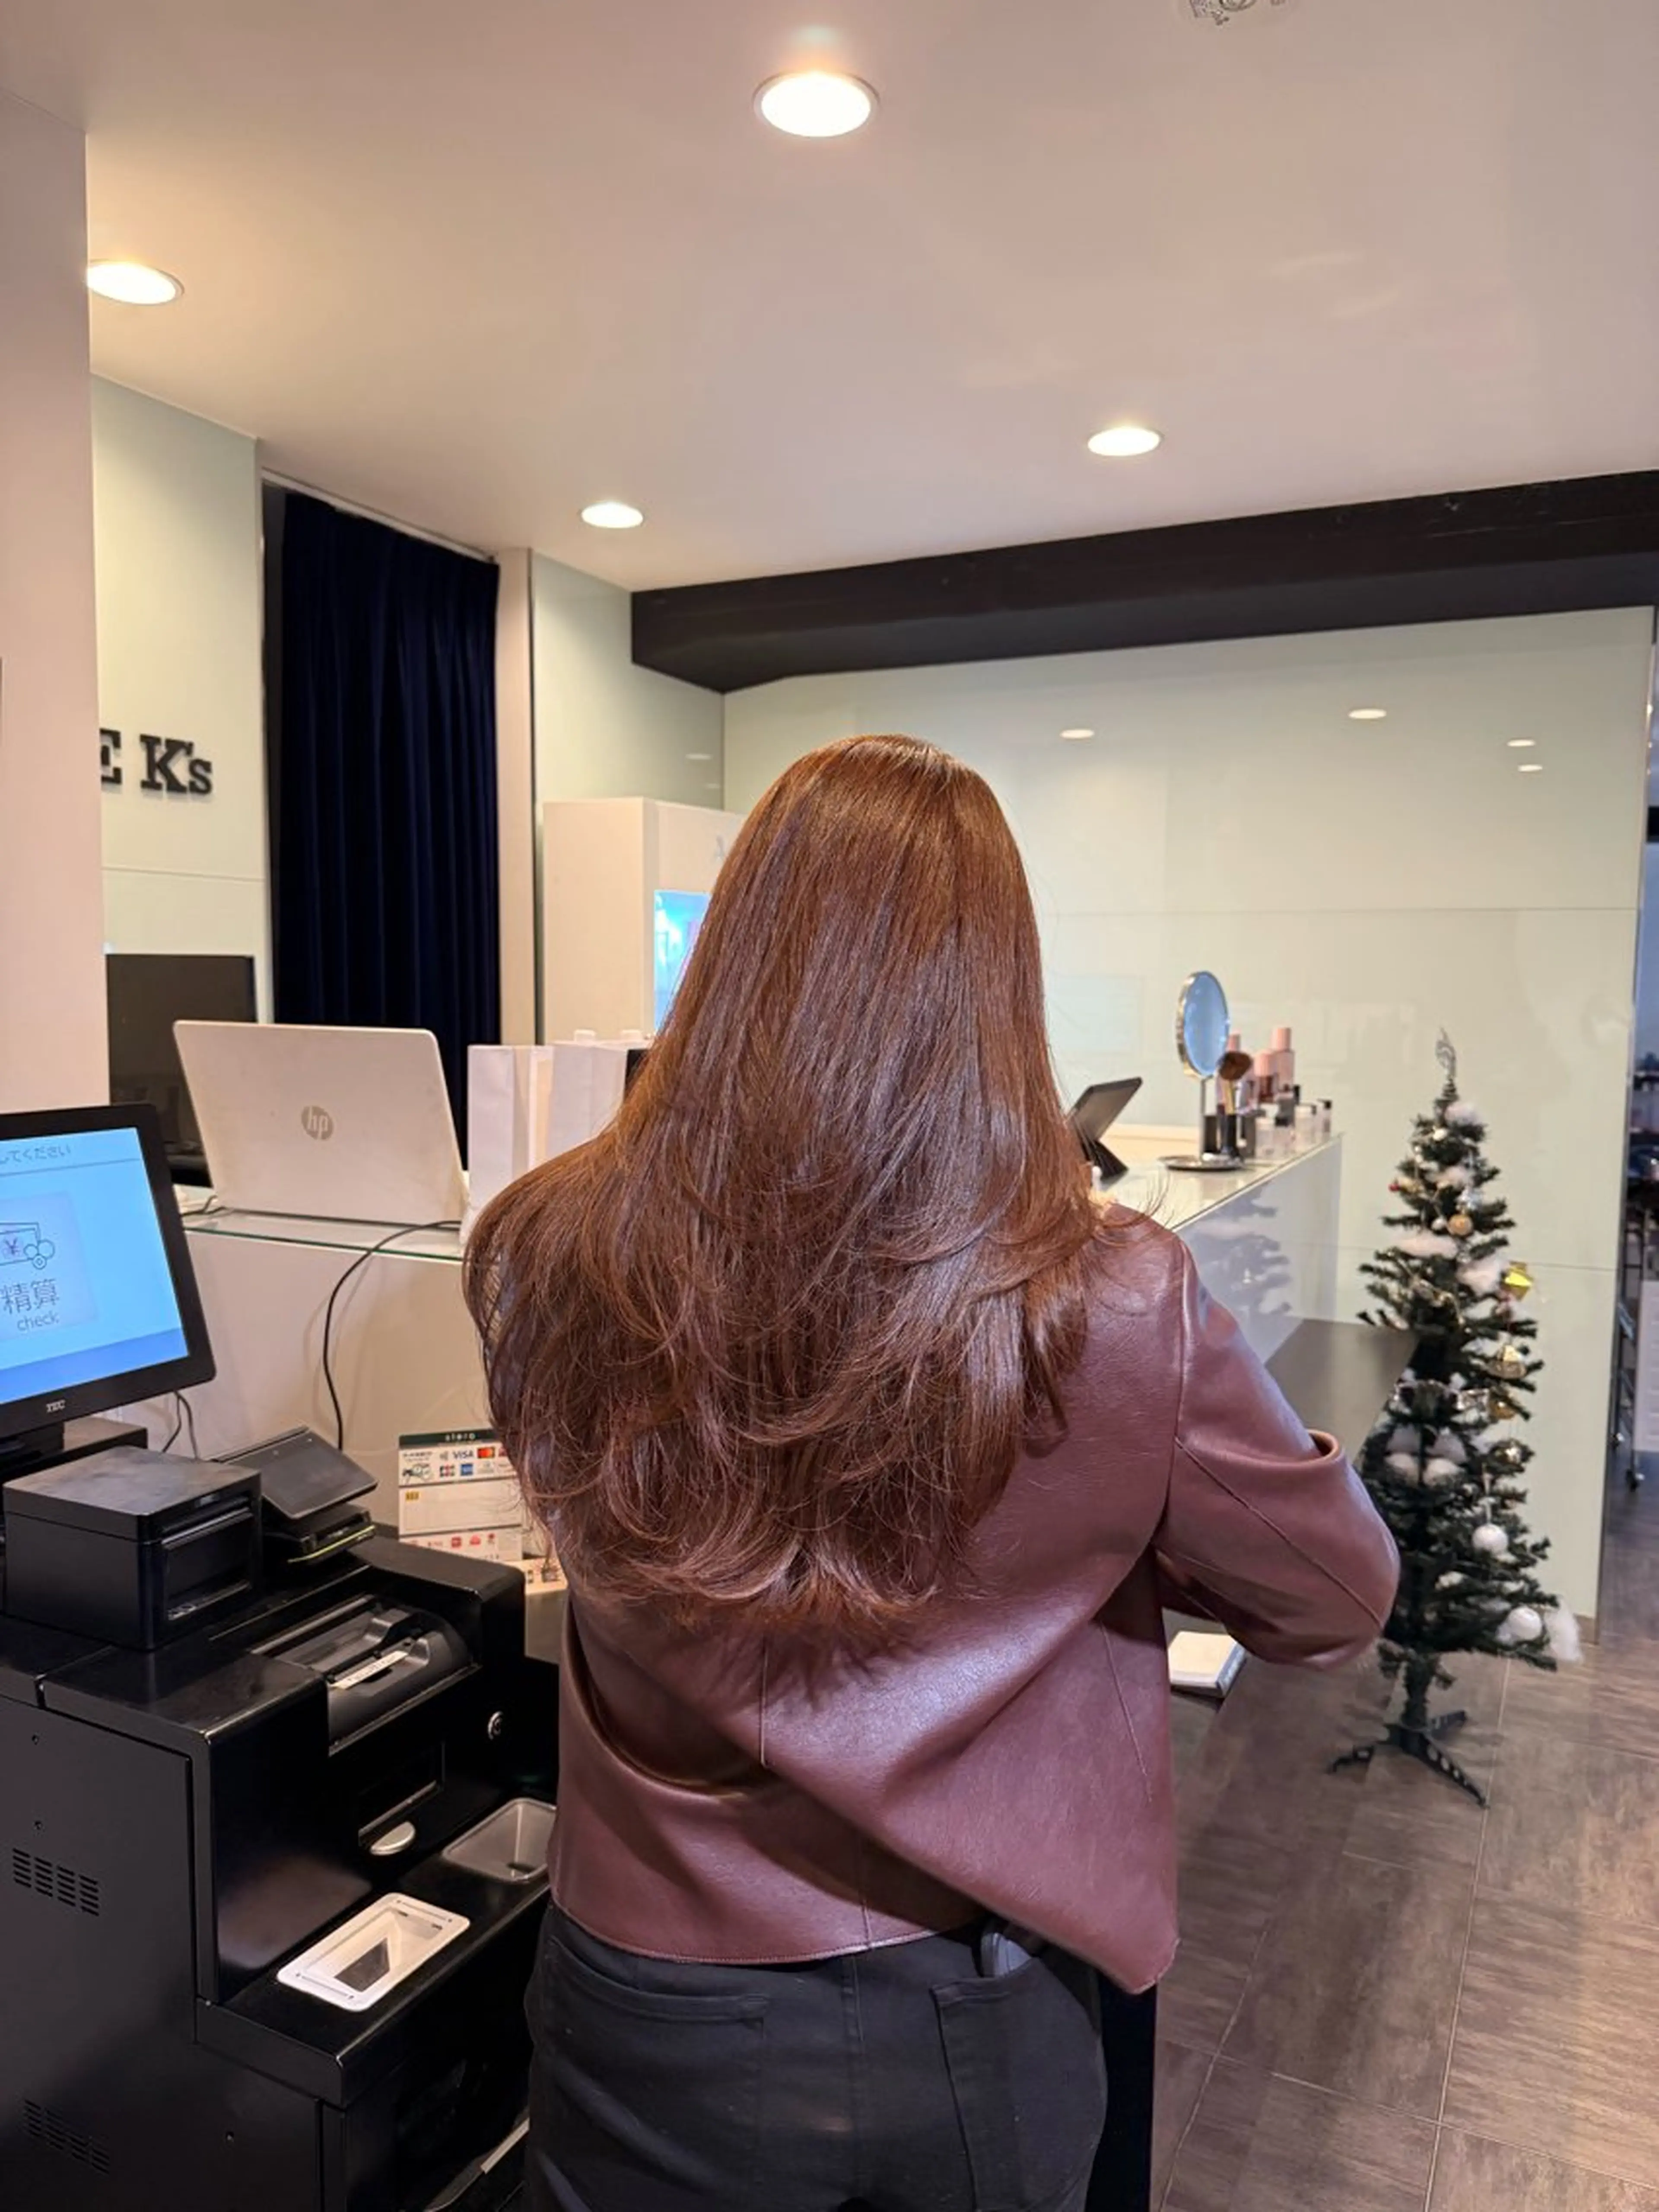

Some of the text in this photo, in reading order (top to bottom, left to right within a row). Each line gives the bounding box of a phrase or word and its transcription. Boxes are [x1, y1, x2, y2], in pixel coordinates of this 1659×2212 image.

[304, 1105, 332, 1141] hp
[0, 1279, 59, 1314] 精算
[17, 1311, 59, 1331] check
[46, 1400, 65, 1413] TEC
[453, 1450, 474, 1459] VISA
